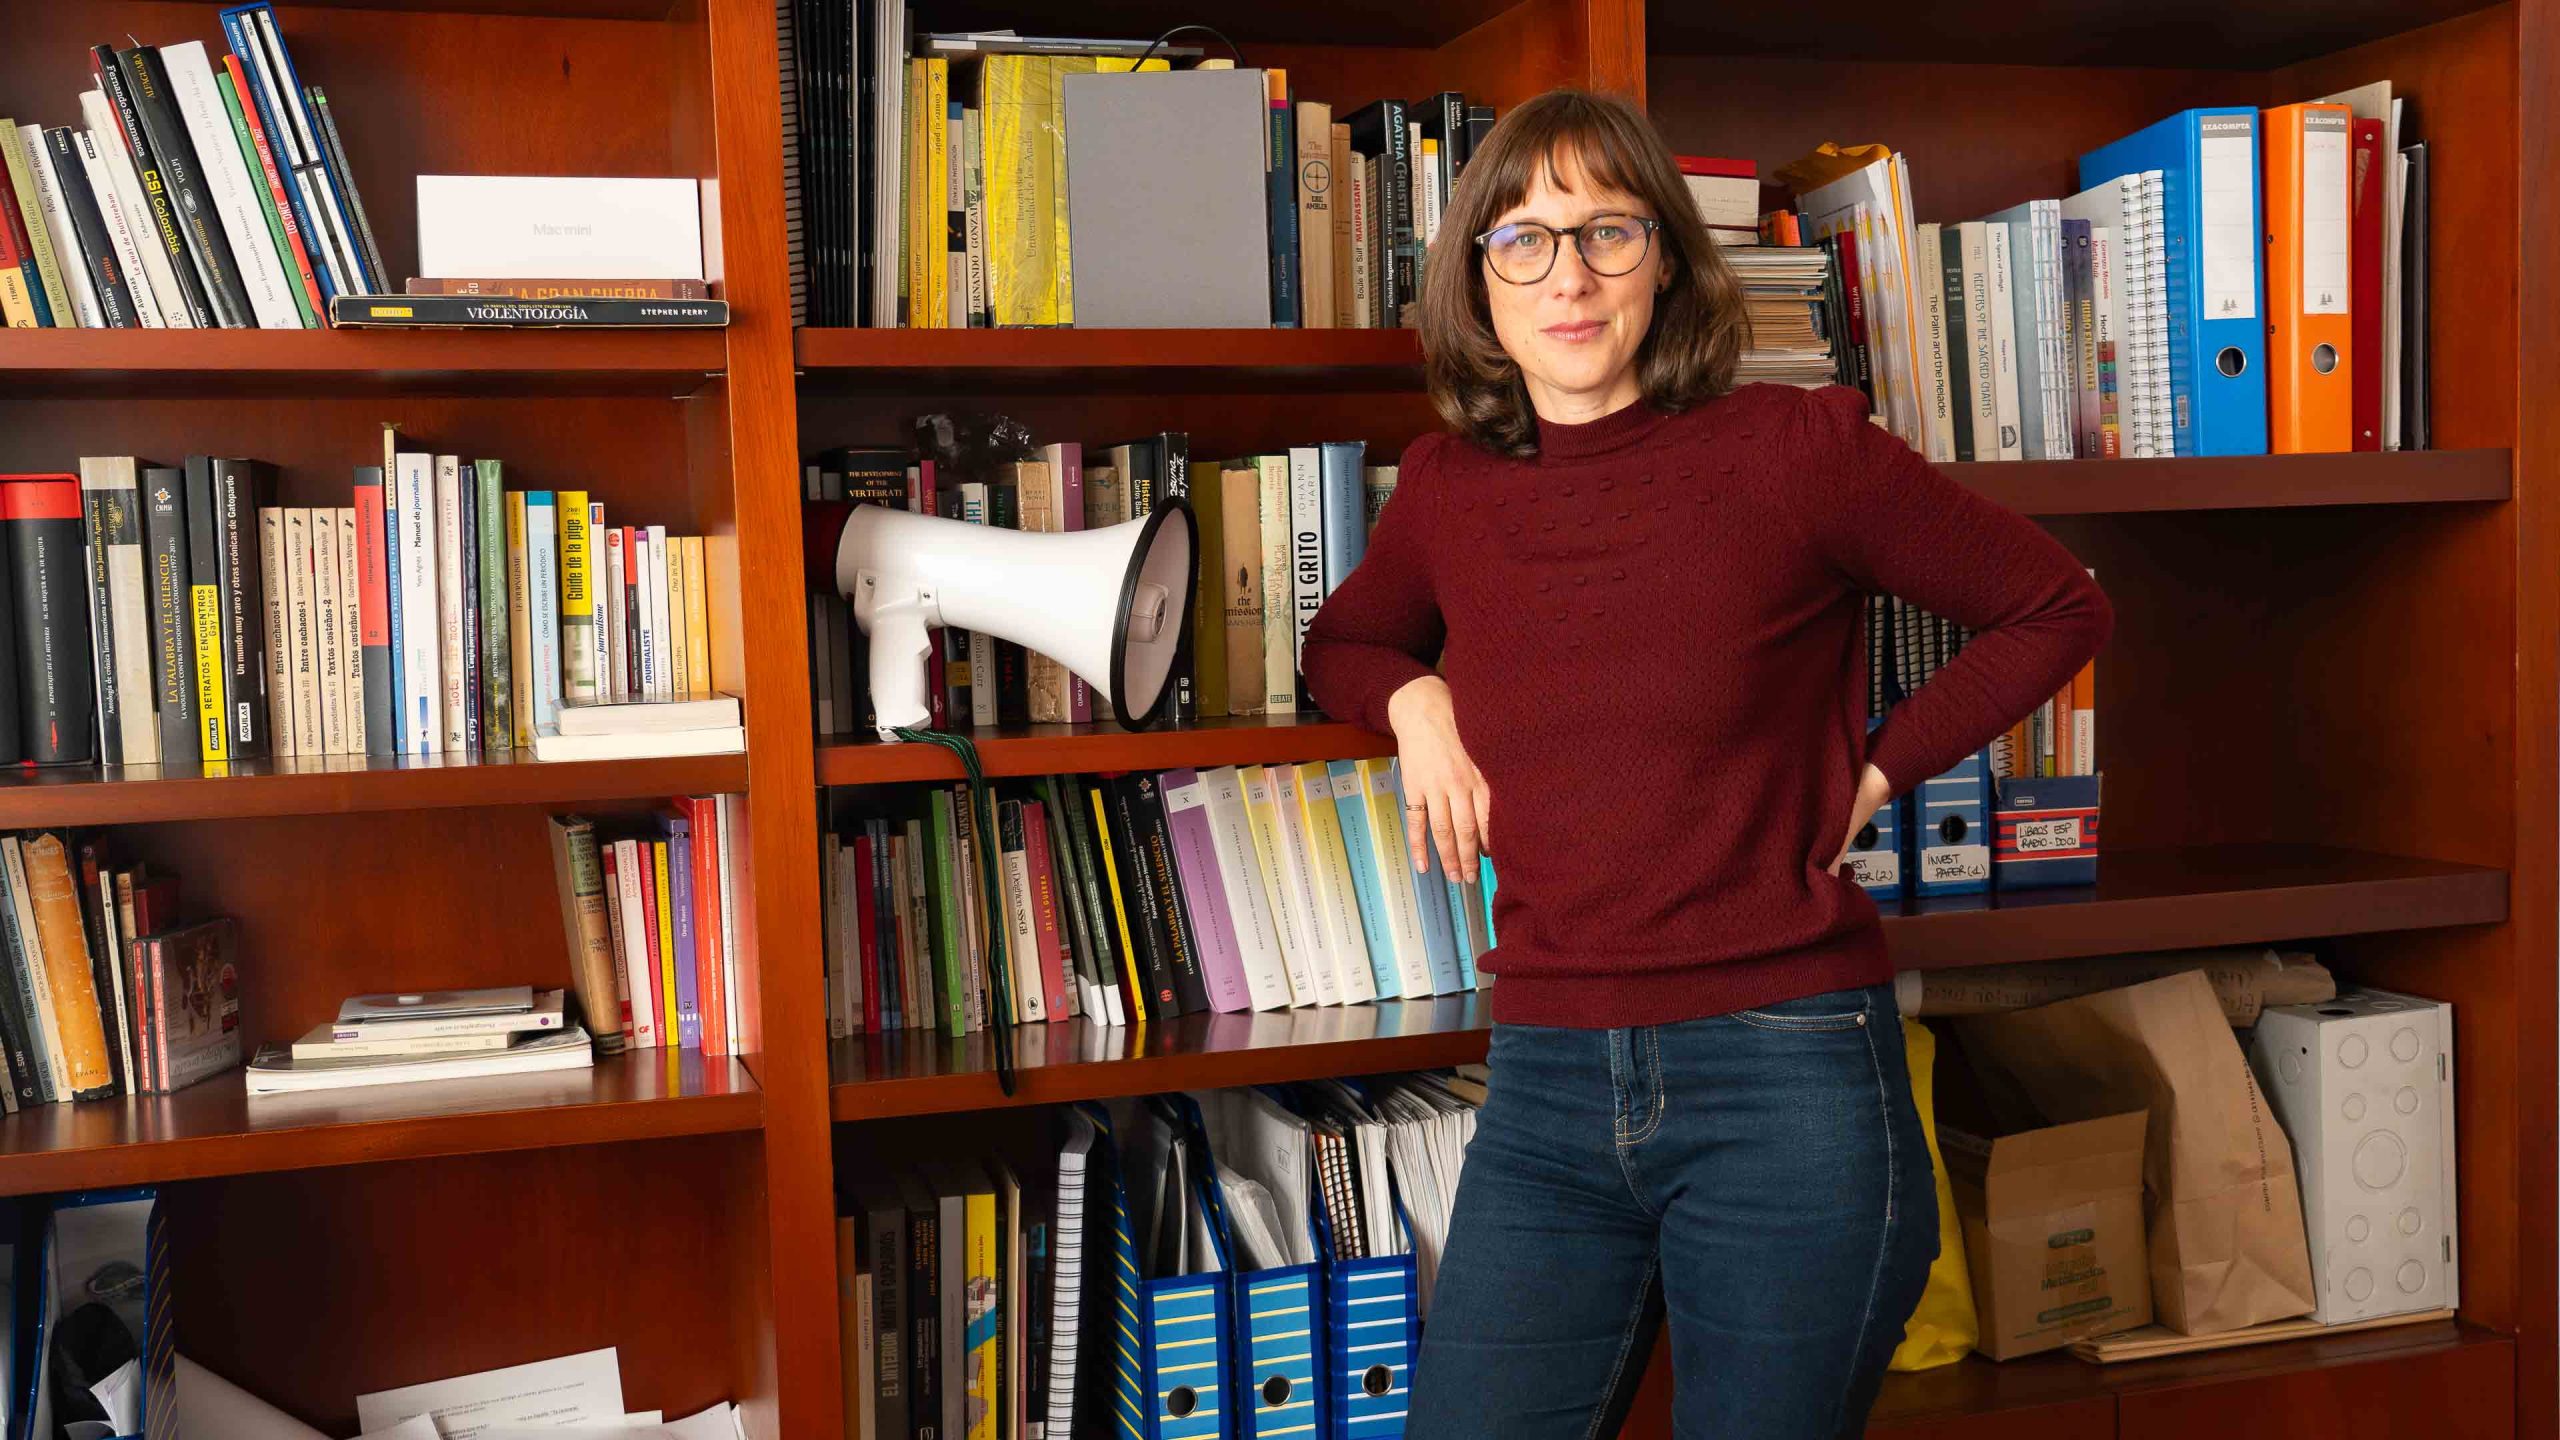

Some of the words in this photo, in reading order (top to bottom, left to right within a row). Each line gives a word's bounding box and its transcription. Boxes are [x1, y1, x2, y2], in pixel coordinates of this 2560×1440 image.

[106, 65, 127, 108] Fernando
[122, 108, 145, 158] Salamanca
[2305, 117, 2346, 126] EXACOMPTA
[1392, 104, 1404, 160] AGATHA
[2202, 122, 2251, 131] EXACOMPTA
[171, 158, 186, 184] VOLPI
[1024, 163, 1035, 179] los
[1024, 180, 1035, 193] de
[1395, 160, 1409, 221] CHRISTIE
[105, 191, 127, 234] Ouistreham
[143, 170, 159, 195] CSI
[154, 197, 180, 256] Colombia
[278, 200, 292, 222] ONCE
[1352, 177, 1362, 242] MAUPASSANT
[194, 218, 209, 248] criminal
[286, 219, 299, 236] LOS
[534, 223, 563, 236] Mac
[564, 223, 592, 236] mini
[1025, 195, 1036, 257] Universidad
[121, 234, 131, 246] de
[2090, 240, 2099, 261] Marta
[125, 245, 138, 265] quai
[1355, 264, 1364, 275] de
[2092, 262, 2100, 278] Ruiz
[127, 276, 145, 309] Aubenas
[970, 254, 981, 313] FERNANDO
[1356, 277, 1365, 299] Boule
[1972, 272, 1986, 311] KEEPERS
[103, 286, 121, 321] Jablonka
[467, 306, 589, 320] VIOLENTOLOGÍA
[640, 308, 679, 316] STEPHEN
[681, 308, 709, 316] FERRY
[1927, 295, 1939, 311] The
[2081, 299, 2092, 328] HUMO
[1929, 314, 1941, 339] Palm
[2098, 314, 2109, 349] Hechos
[1931, 340, 1942, 358] and
[1977, 343, 1990, 378] SACRED
[1856, 344, 1869, 381] teaching
[1933, 360, 1944, 377] the
[1934, 378, 1947, 418] Pleiades
[2103, 431, 2115, 456] DEBATE
[848, 470, 861, 478] THE
[225, 474, 238, 518] Gatopardo
[411, 468, 421, 510] journalisme
[1134, 479, 1142, 500] Carlos
[1141, 479, 1151, 515] Historia
[1296, 463, 1307, 517] JOHANN
[1307, 474, 1316, 506] HARI
[228, 518, 239, 529] de
[413, 521, 422, 547] Manuel
[565, 518, 583, 540] pige
[228, 529, 240, 565] crónicas
[565, 542, 582, 553] la
[1298, 531, 1318, 584] GRITO
[539, 548, 547, 578] PERIÓDICO
[565, 555, 582, 569] de
[158, 553, 172, 608] SILENCIO
[171, 571, 180, 604] COLOMBIA
[230, 565, 242, 587] otras
[513, 555, 522, 602] JOURNALISME
[566, 571, 583, 600] Guide
[97, 586, 107, 605] actual
[206, 587, 216, 616] Talese
[231, 596, 243, 614] raro
[540, 589, 548, 610] ESCRIBE
[1236, 595, 1251, 606] the
[162, 610, 173, 624] EL
[196, 588, 209, 651] ENCUENTROS
[232, 615, 244, 633] muy
[270, 599, 283, 648] cachacos-2
[296, 599, 308, 646] cachacos-1
[322, 598, 334, 645] costeños-2
[1224, 605, 1262, 617] mission
[98, 605, 111, 653] latinoamericana
[173, 614, 183, 652] PERIODISTAS
[207, 618, 217, 636] Gay
[348, 602, 359, 647] costeños-1
[541, 619, 549, 638] CÓMO
[594, 603, 607, 654] journalisme
[164, 635, 177, 686] PALABRA
[233, 633, 245, 662] mundo
[299, 648, 309, 672] Entre
[642, 628, 652, 684] JOURNALISTE
[102, 653, 112, 675] crónica
[176, 653, 185, 678] CONTRA
[234, 662, 246, 675] Un
[273, 649, 284, 675] Entre
[325, 646, 336, 676] Textos
[349, 649, 360, 678] Textos
[201, 660, 212, 709] RETRATOS
[974, 665, 985, 688] Carr
[104, 682, 115, 714] Antología
[167, 688, 179, 703] LA
[178, 678, 187, 710] VIOLENCIA
[1270, 695, 1293, 703] DEBATE
[209, 717, 218, 749] AGUILAR
[240, 704, 249, 739] AGUILAR
[2053, 822, 2073, 835] ESP
[1008, 855, 1021, 872] Len
[1151, 834, 1169, 883] SILENCIO
[1010, 872, 1025, 909] Deighton
[1038, 873, 1050, 905] GUERRA
[1143, 873, 1154, 899] Caballero
[1160, 883, 1171, 894] EL
[1042, 907, 1052, 917] LA
[1044, 919, 1053, 931] DE
[1165, 906, 1182, 948] PALABRA
[1173, 949, 1185, 962] LA
[14, 1049, 25, 1066] SON
[881, 1332, 898, 1381] INTERIOR
[882, 1383, 899, 1397] EL
